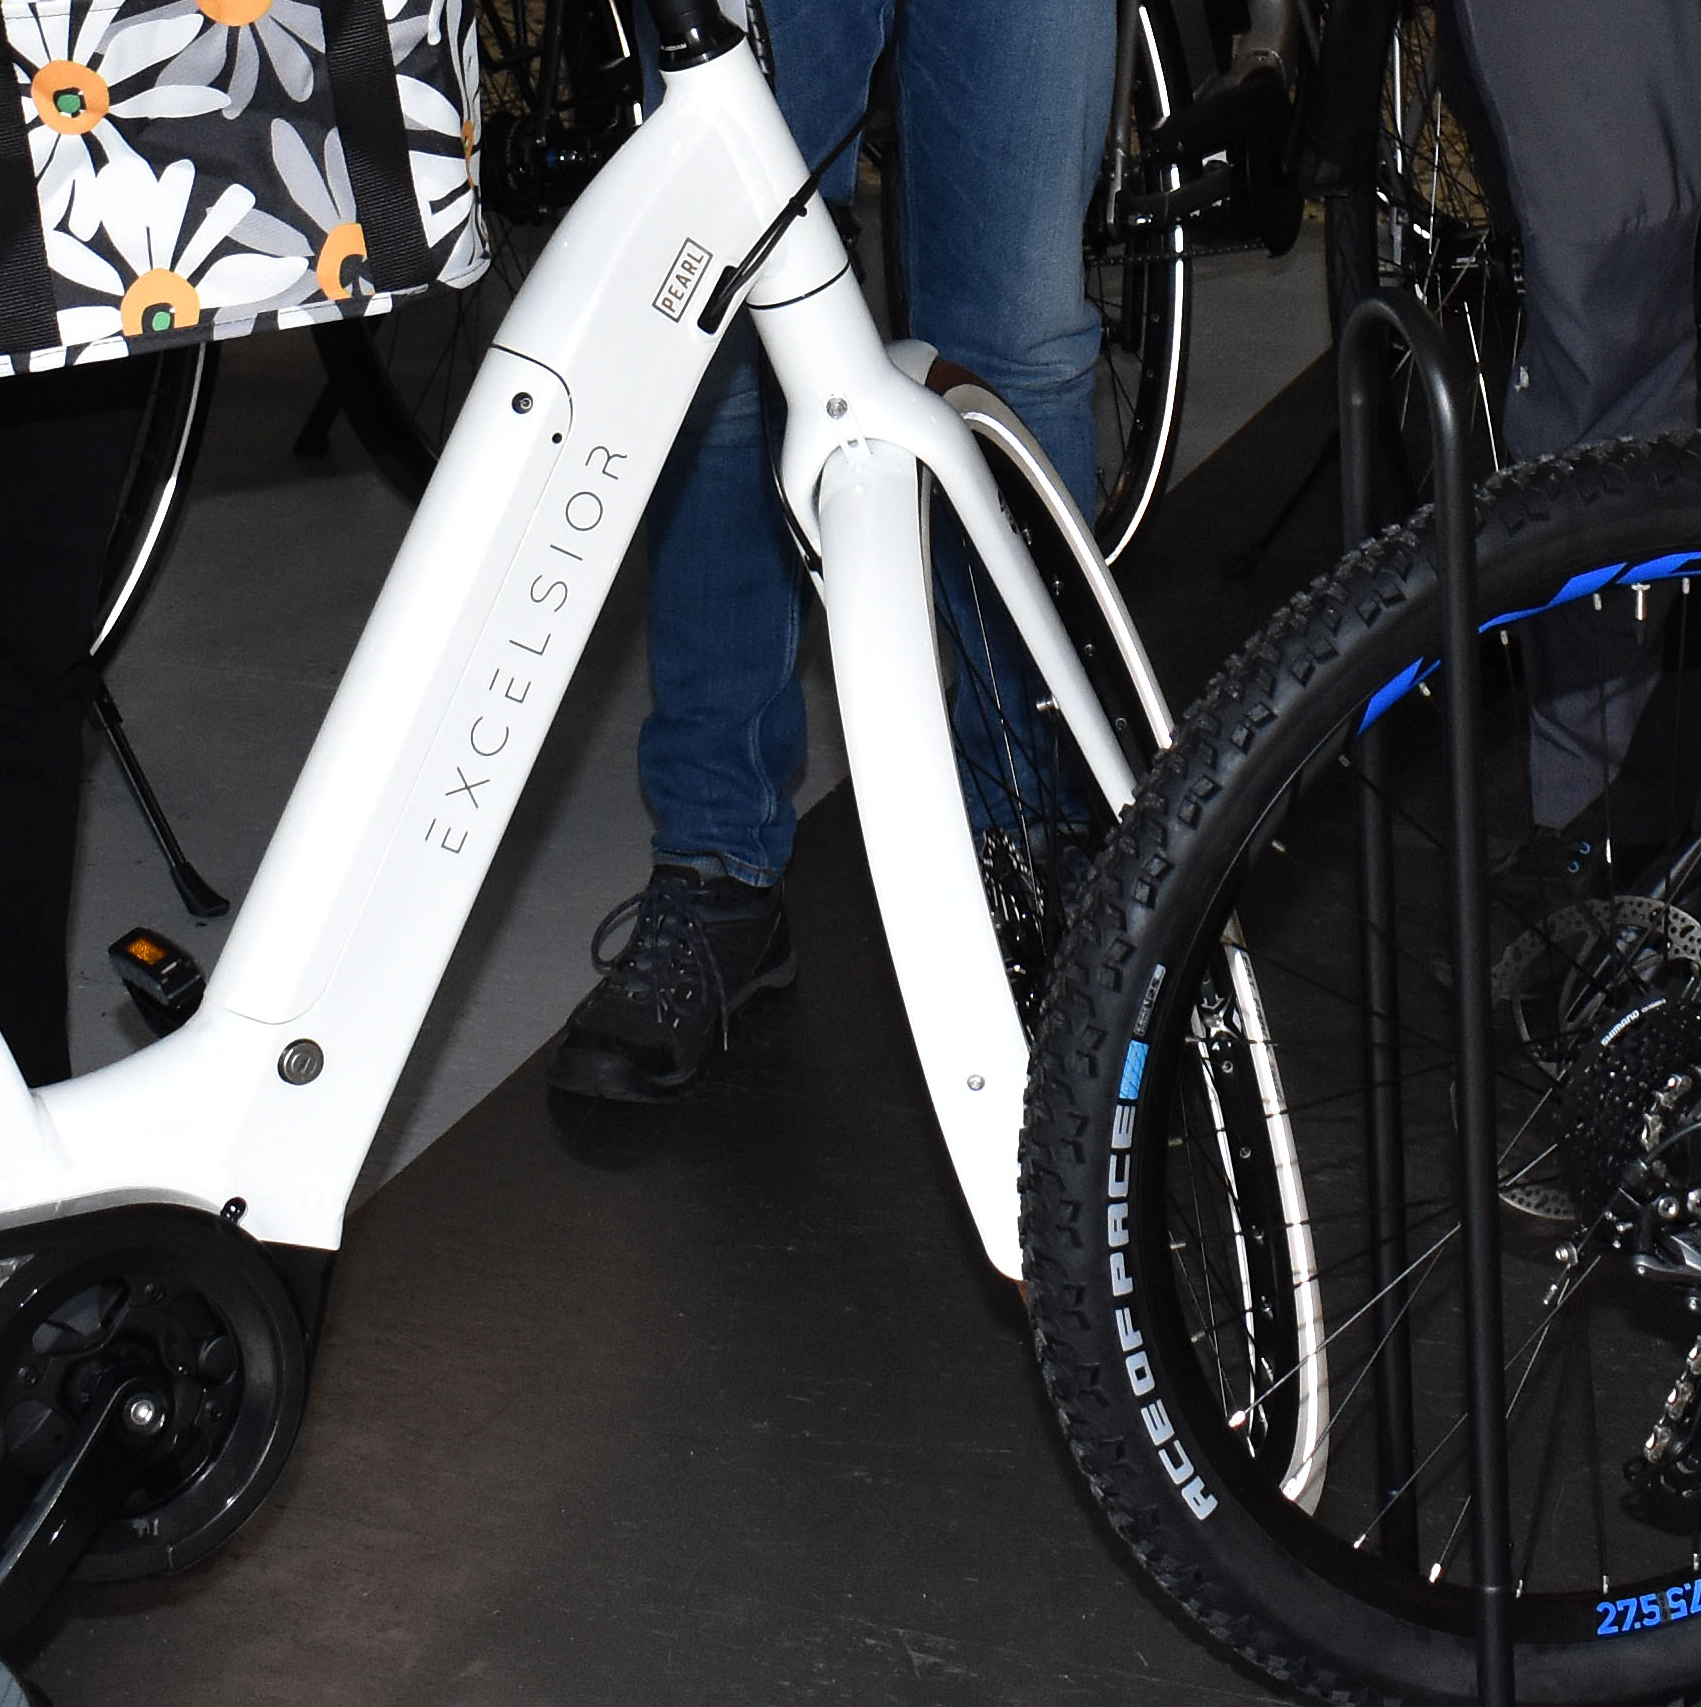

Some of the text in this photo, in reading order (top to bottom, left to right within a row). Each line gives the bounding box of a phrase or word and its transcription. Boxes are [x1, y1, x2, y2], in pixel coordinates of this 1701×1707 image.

[662, 248, 707, 320] PEARL
[425, 443, 628, 855] EXCELSIOR
[1597, 1592, 1662, 1635] 27.5
